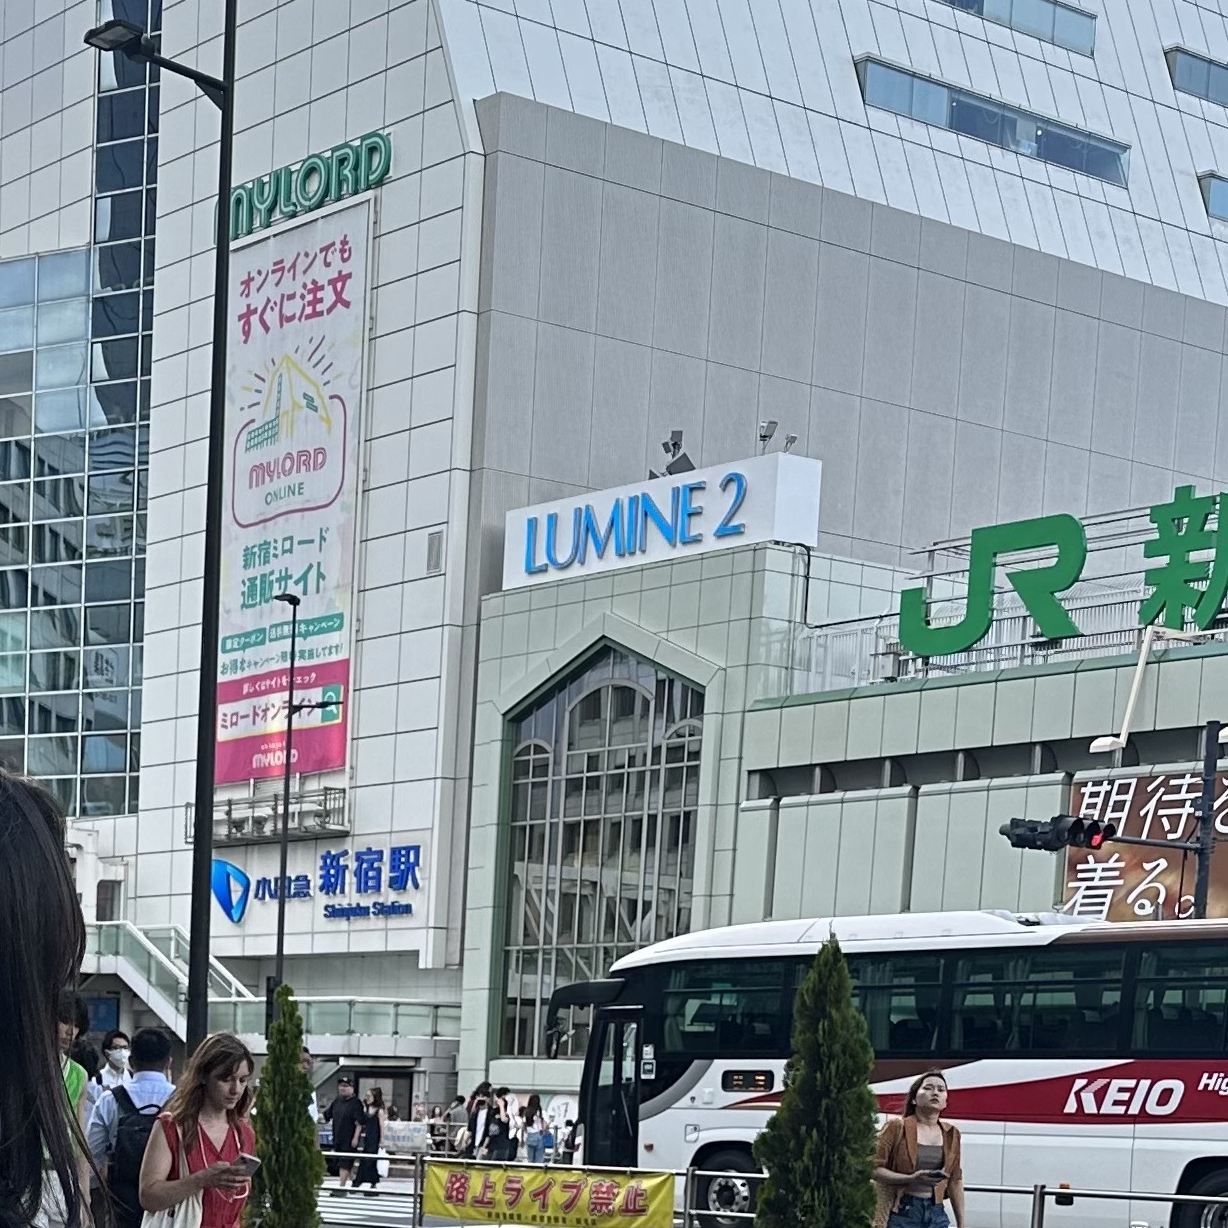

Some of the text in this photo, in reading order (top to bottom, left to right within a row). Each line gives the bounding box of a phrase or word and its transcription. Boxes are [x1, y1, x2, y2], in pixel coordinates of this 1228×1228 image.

[239, 233, 352, 299] オンラインでも
[237, 269, 353, 345] すぐに注文
[264, 481, 305, 506] ONLINE
[242, 526, 330, 571] 新宿ミロード
[524, 471, 748, 575] LUMINE 2
[240, 561, 326, 610] 通販サイト
[899, 513, 1089, 657] JR
[318, 844, 422, 897] 新宿駅
[1062, 852, 1195, 921] 着る。
[1063, 1078, 1186, 1116] KEIO
[444, 1170, 649, 1218] 路上ライブ禁止
